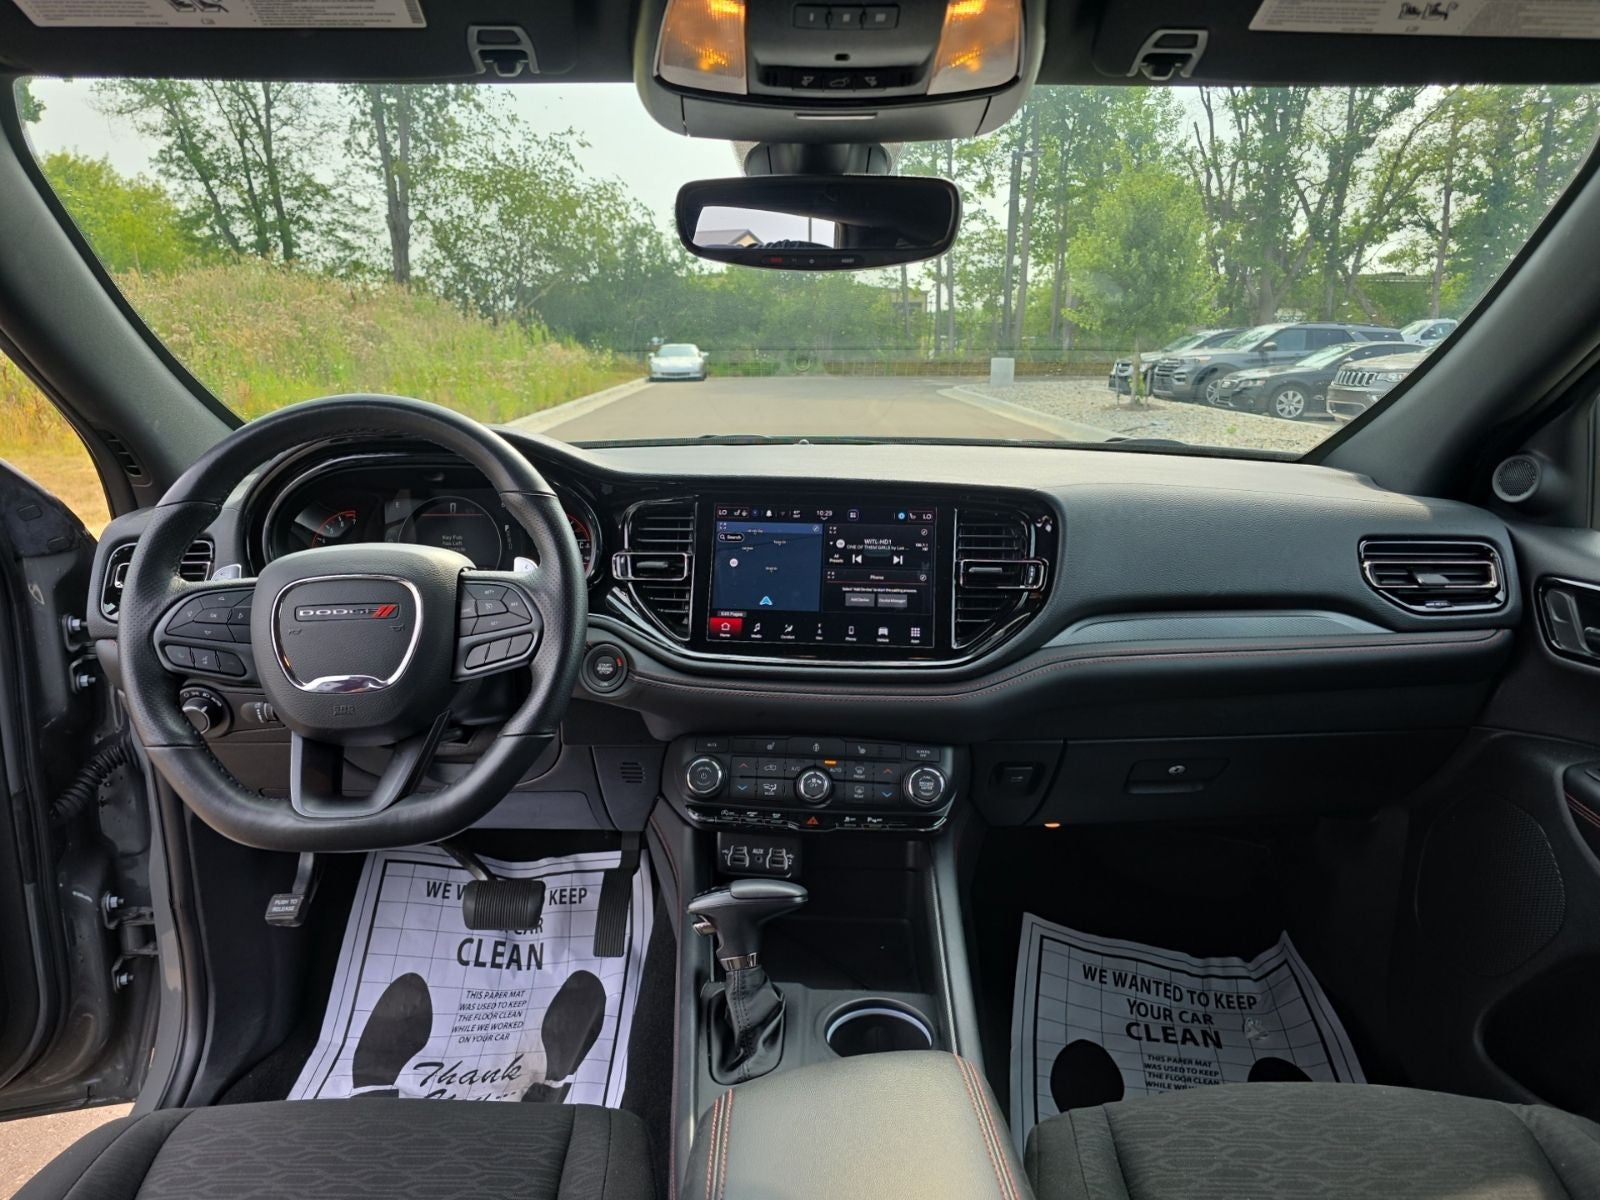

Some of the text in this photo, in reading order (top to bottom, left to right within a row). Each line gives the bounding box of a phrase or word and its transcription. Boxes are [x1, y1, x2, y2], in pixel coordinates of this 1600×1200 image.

[816, 509, 833, 517] 10:29
[298, 608, 378, 617] DODGE
[426, 880, 452, 900] WE
[548, 887, 588, 906] KEEP
[456, 938, 544, 971] CLEAN
[1082, 963, 1257, 1011] WE WANTED TO KEEP
[466, 990, 526, 1000] THIS PAPER MAT
[459, 1000, 527, 1011] WAS USED TO KEEP
[1126, 998, 1213, 1025] YOUR CAR
[458, 1010, 522, 1022] THE FLOOR CLEAN
[452, 1021, 524, 1033] WHILE WE WORKED
[458, 1033, 510, 1044] ON YOUR CAR
[1125, 1021, 1223, 1050] CLEAN
[1147, 1054, 1212, 1068] THIS PAPER MAT
[412, 1055, 523, 1088] Thank
[1144, 1063, 1219, 1077] WAS USED TO KEEP
[1145, 1081, 1172, 1090] WHILE
[1147, 1071, 1220, 1086] THE FLOOR CLEAN
